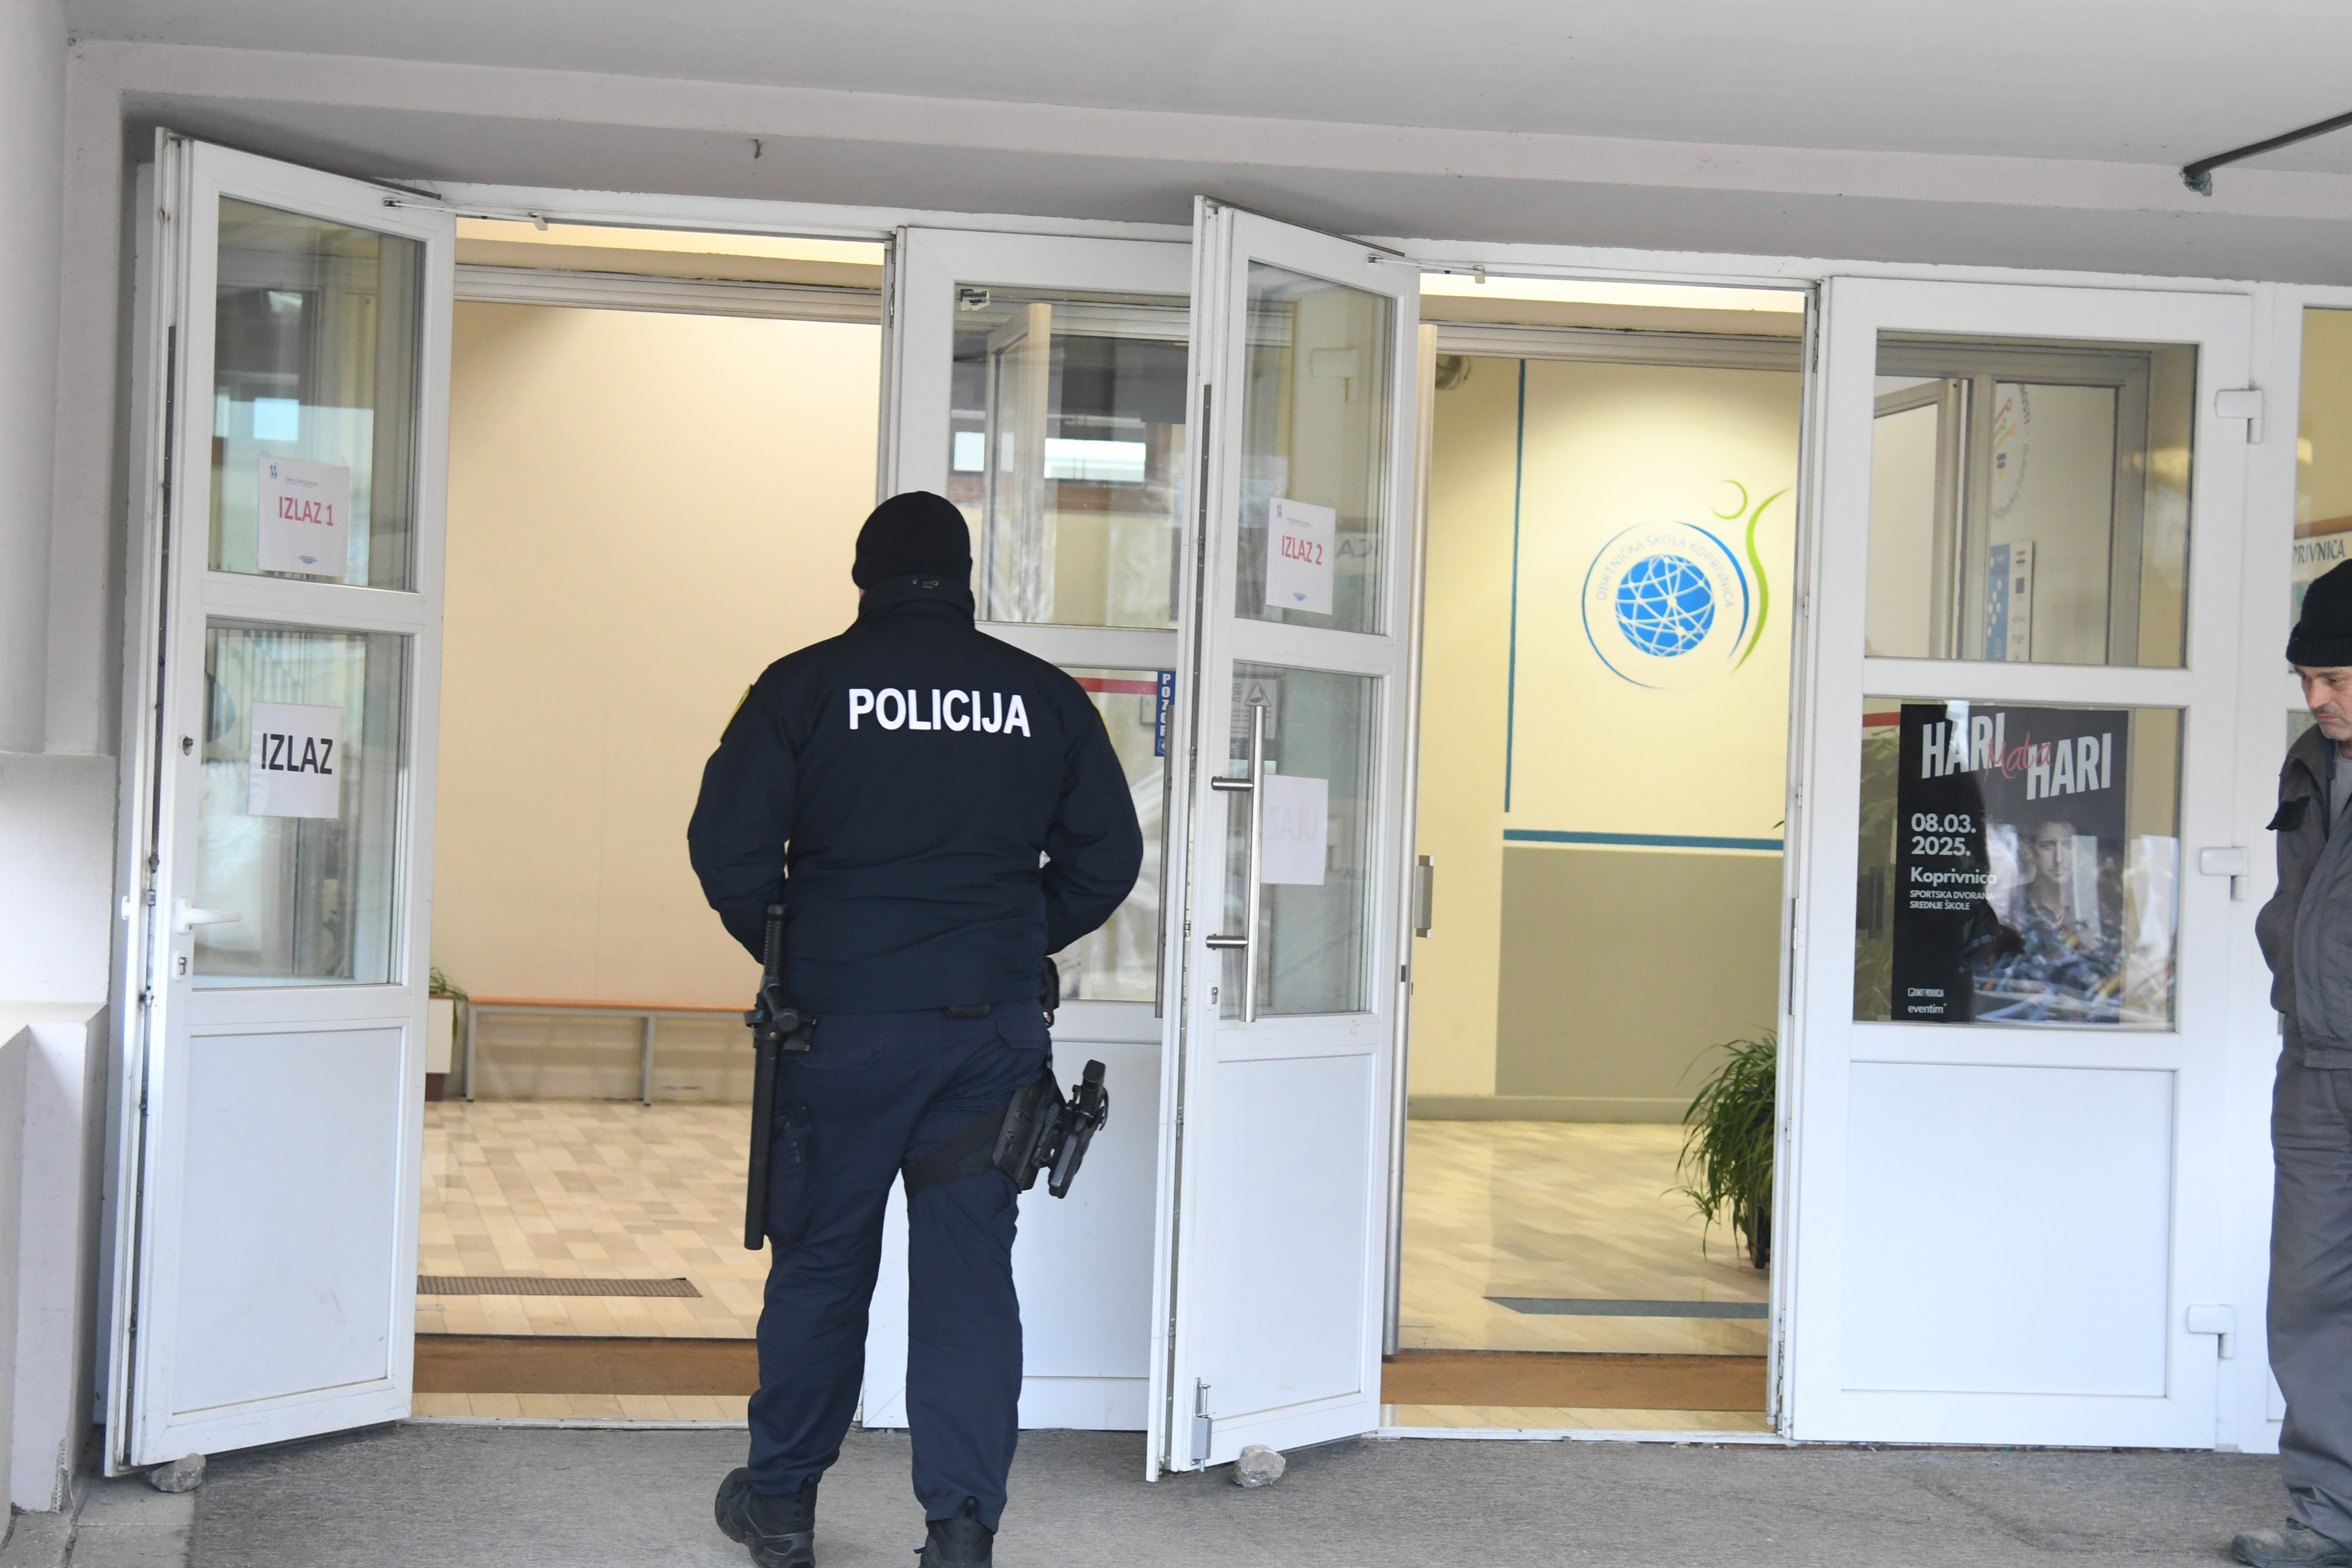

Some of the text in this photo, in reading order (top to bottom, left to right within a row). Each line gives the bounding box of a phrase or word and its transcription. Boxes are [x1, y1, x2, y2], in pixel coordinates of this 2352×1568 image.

[279, 496, 334, 527] IZLAZ 1
[1281, 534, 1313, 563] IZLAZ
[1315, 543, 1323, 566] 2
[1596, 534, 1734, 608] OBRTNIČKA ŠKOLA KOPRIVNICA
[848, 687, 1031, 738] POLICIJA
[261, 733, 333, 775] IZLAZ
[1921, 711, 2112, 801] HARI Mata HARI
[1911, 813, 1977, 834] 08.03.
[1911, 835, 1972, 857] 2025.
[1910, 867, 1997, 887] Koprivnica
[1910, 890, 1995, 900] SPORTSKA DVORANA
[1910, 899, 1970, 910] SREDNJE ŠKOLE
[1907, 1004, 1944, 1014] eventim
